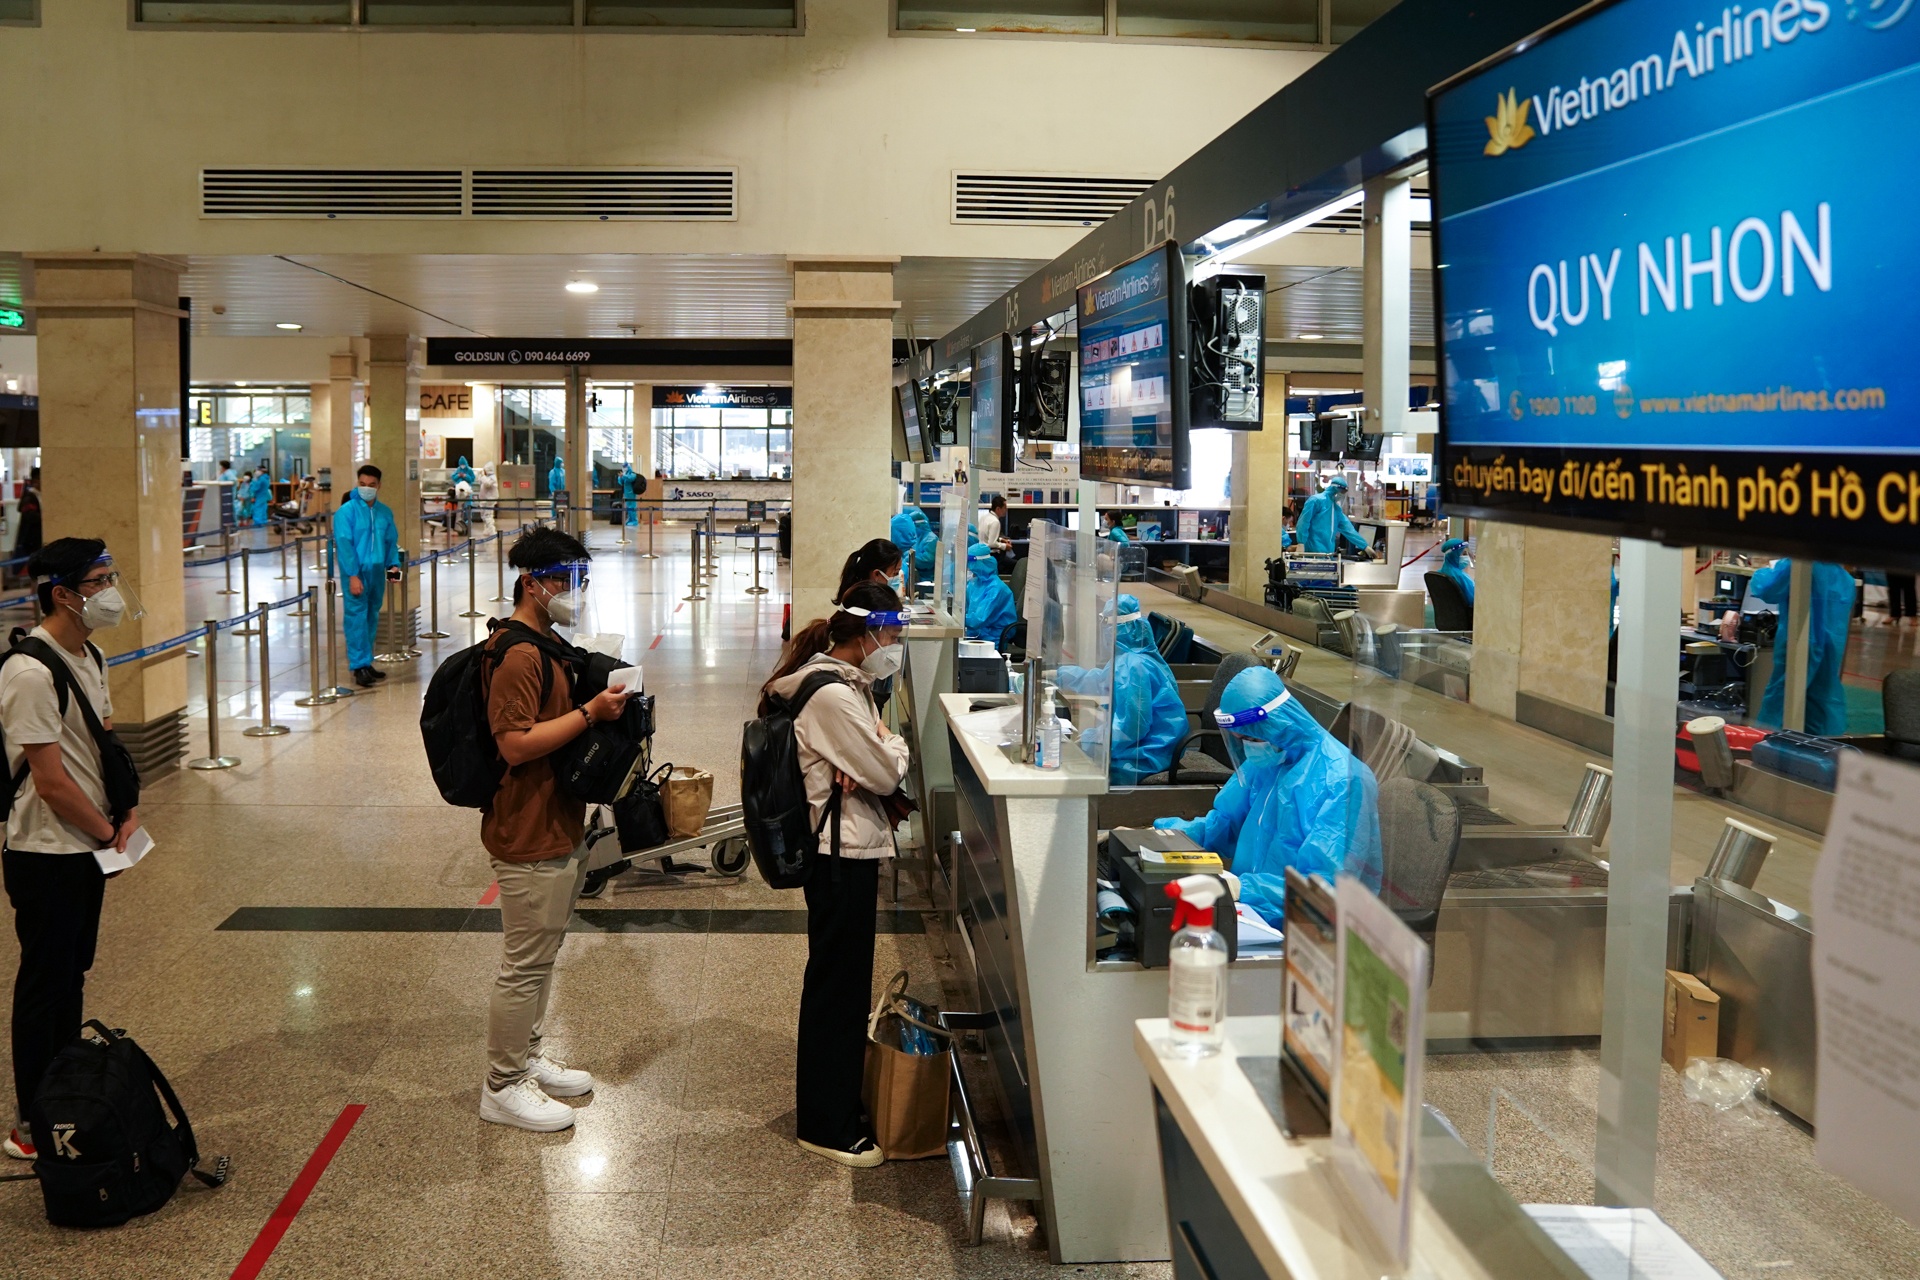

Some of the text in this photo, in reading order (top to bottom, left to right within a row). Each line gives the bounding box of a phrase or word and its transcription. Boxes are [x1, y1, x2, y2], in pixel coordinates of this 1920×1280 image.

[1144, 185, 1176, 250] D-6
[1527, 202, 1832, 336] QUY NHON
[1006, 293, 1019, 330] D-5
[454, 351, 590, 361] GOLDSUN 090 464 6699
[420, 393, 469, 410] CAFE
[1528, 395, 1561, 416] 1900
[1640, 384, 1886, 414] www.vietnamairlines.com
[1453, 455, 1516, 496] chuyến
[1519, 458, 1555, 503] bay
[1558, 457, 1636, 501] đi/đến
[1640, 462, 1729, 509] Thành
[1738, 462, 1803, 522] phố
[1810, 465, 1867, 521] Hồ
